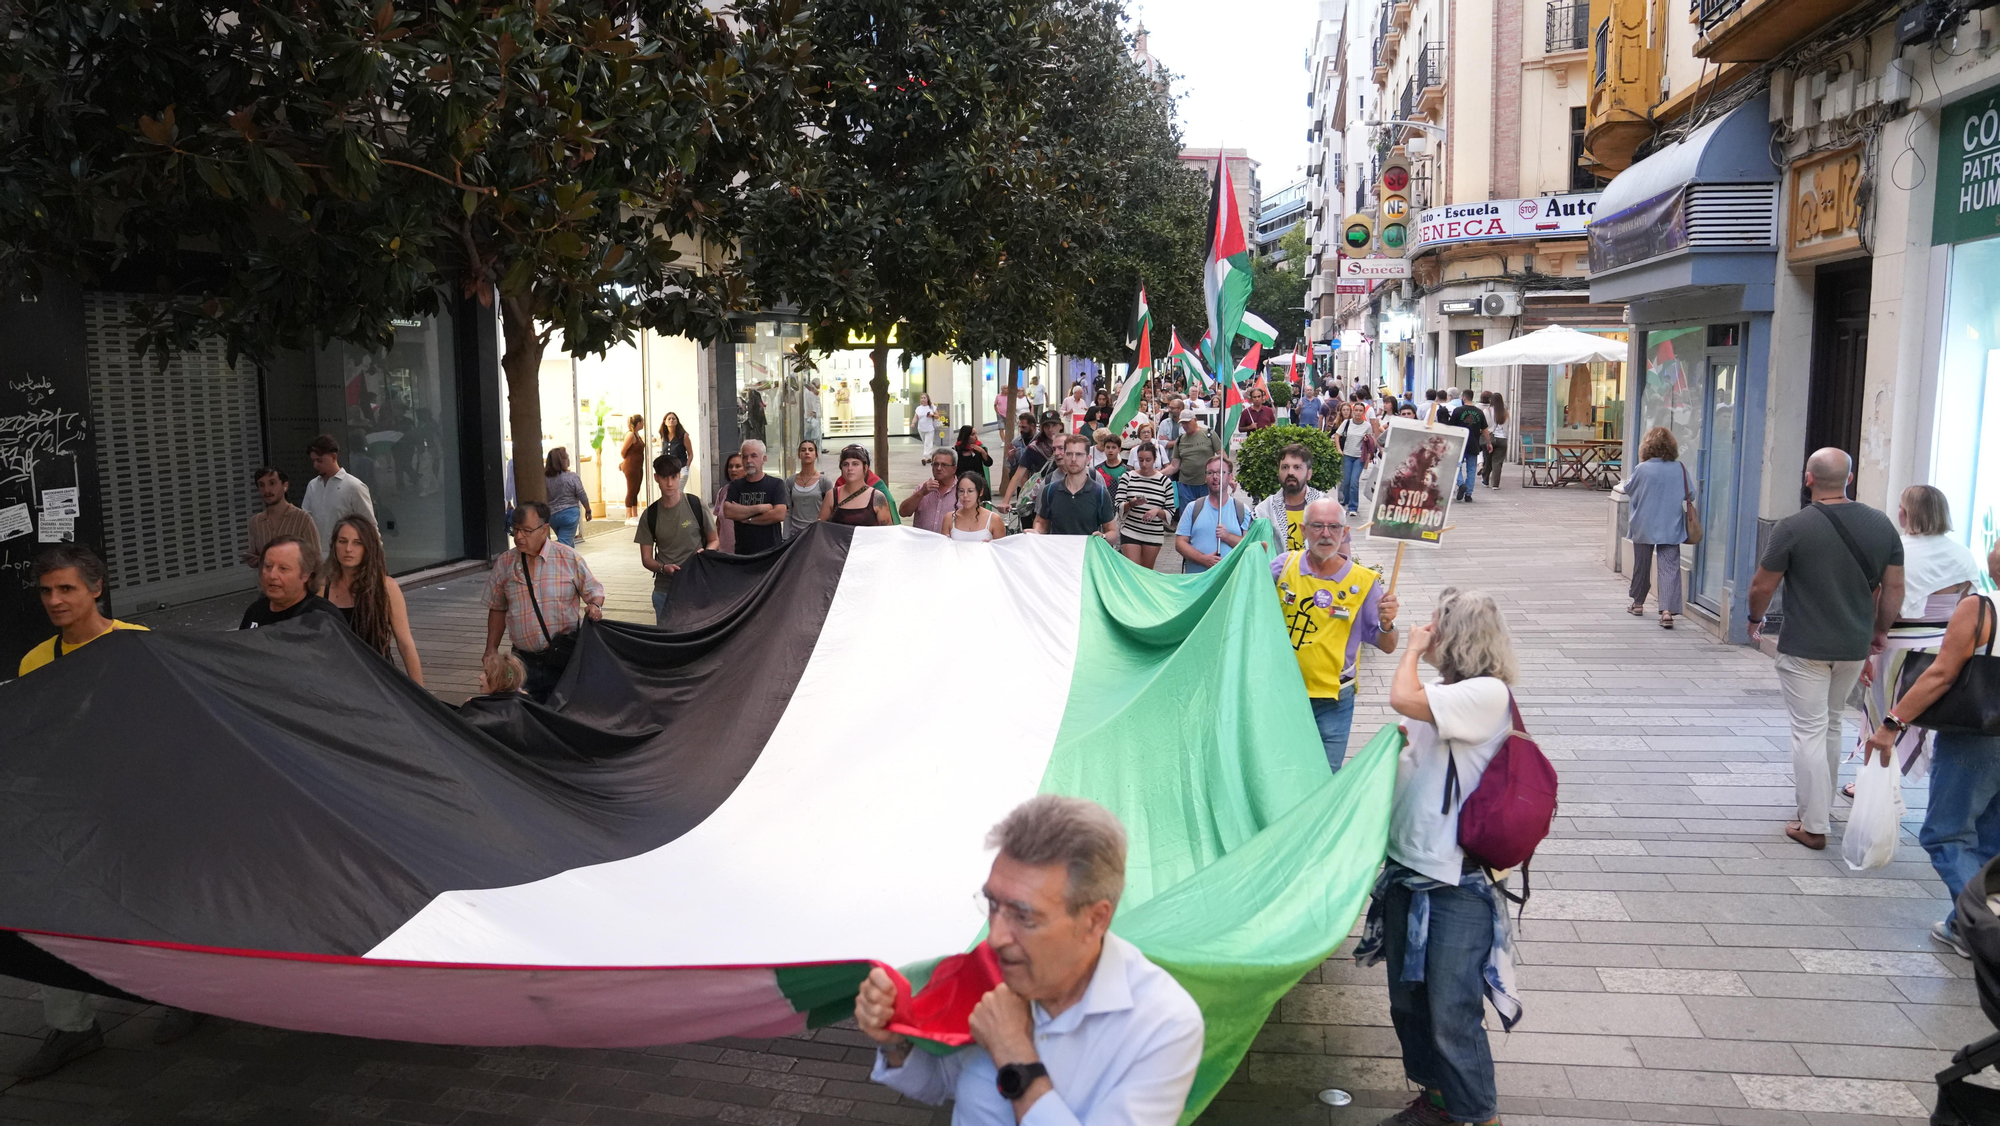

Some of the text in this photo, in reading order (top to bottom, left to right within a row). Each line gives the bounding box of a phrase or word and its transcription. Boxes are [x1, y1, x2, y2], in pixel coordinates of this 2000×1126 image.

[1963, 99, 2000, 152] CÓ
[1387, 172, 1404, 187] SE
[1387, 200, 1404, 215] NE
[1445, 203, 1499, 219] Escuela
[1520, 205, 1536, 214] STOP
[1387, 227, 1403, 243] CA
[1418, 218, 1506, 243] SENECA
[1347, 262, 1405, 276] Seneca
[1397, 489, 1429, 507] STOP
[1377, 504, 1443, 527] GENOCIDIO
